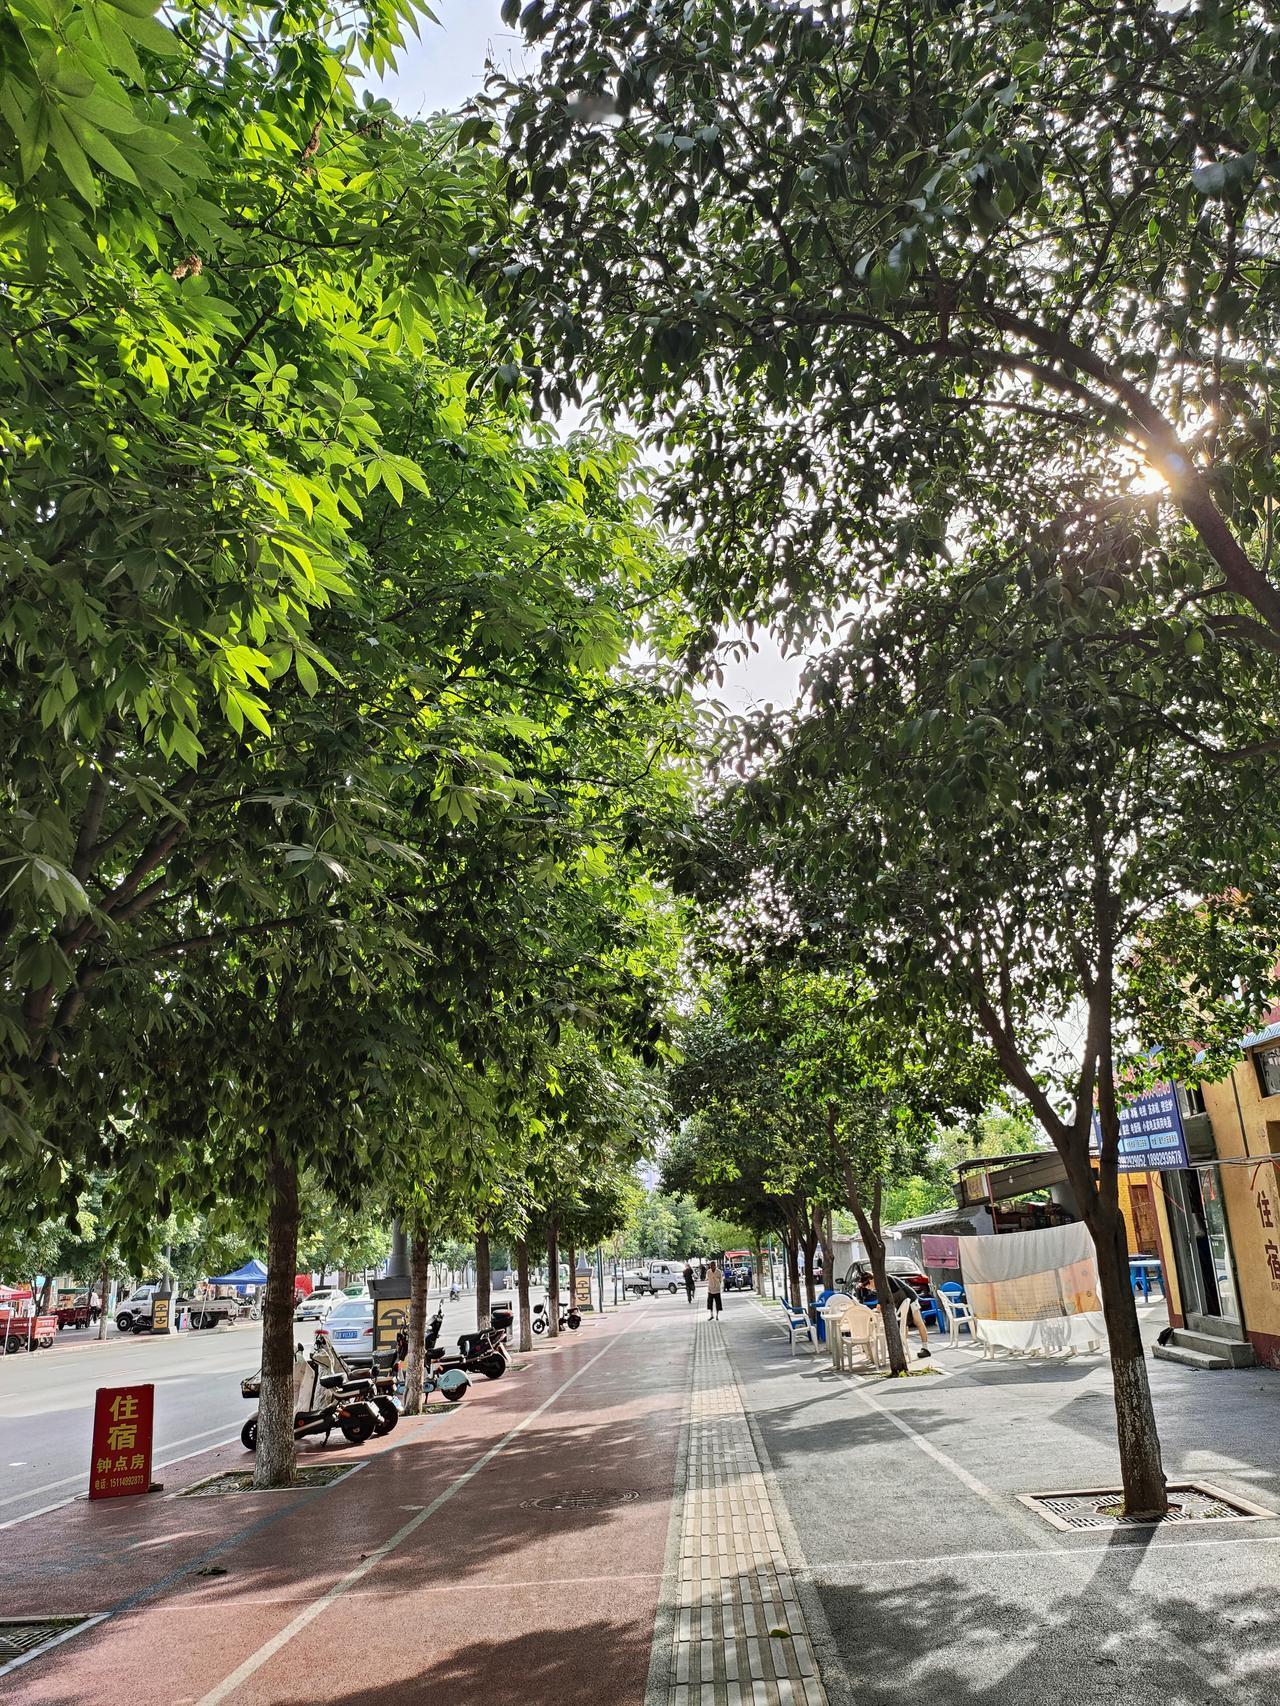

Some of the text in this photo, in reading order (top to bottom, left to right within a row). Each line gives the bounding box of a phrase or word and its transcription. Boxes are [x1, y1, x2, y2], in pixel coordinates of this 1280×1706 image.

[1257, 1190, 1280, 1280] 住宿
[107, 1395, 139, 1451] 住宿
[96, 1454, 145, 1474] 钟点房
